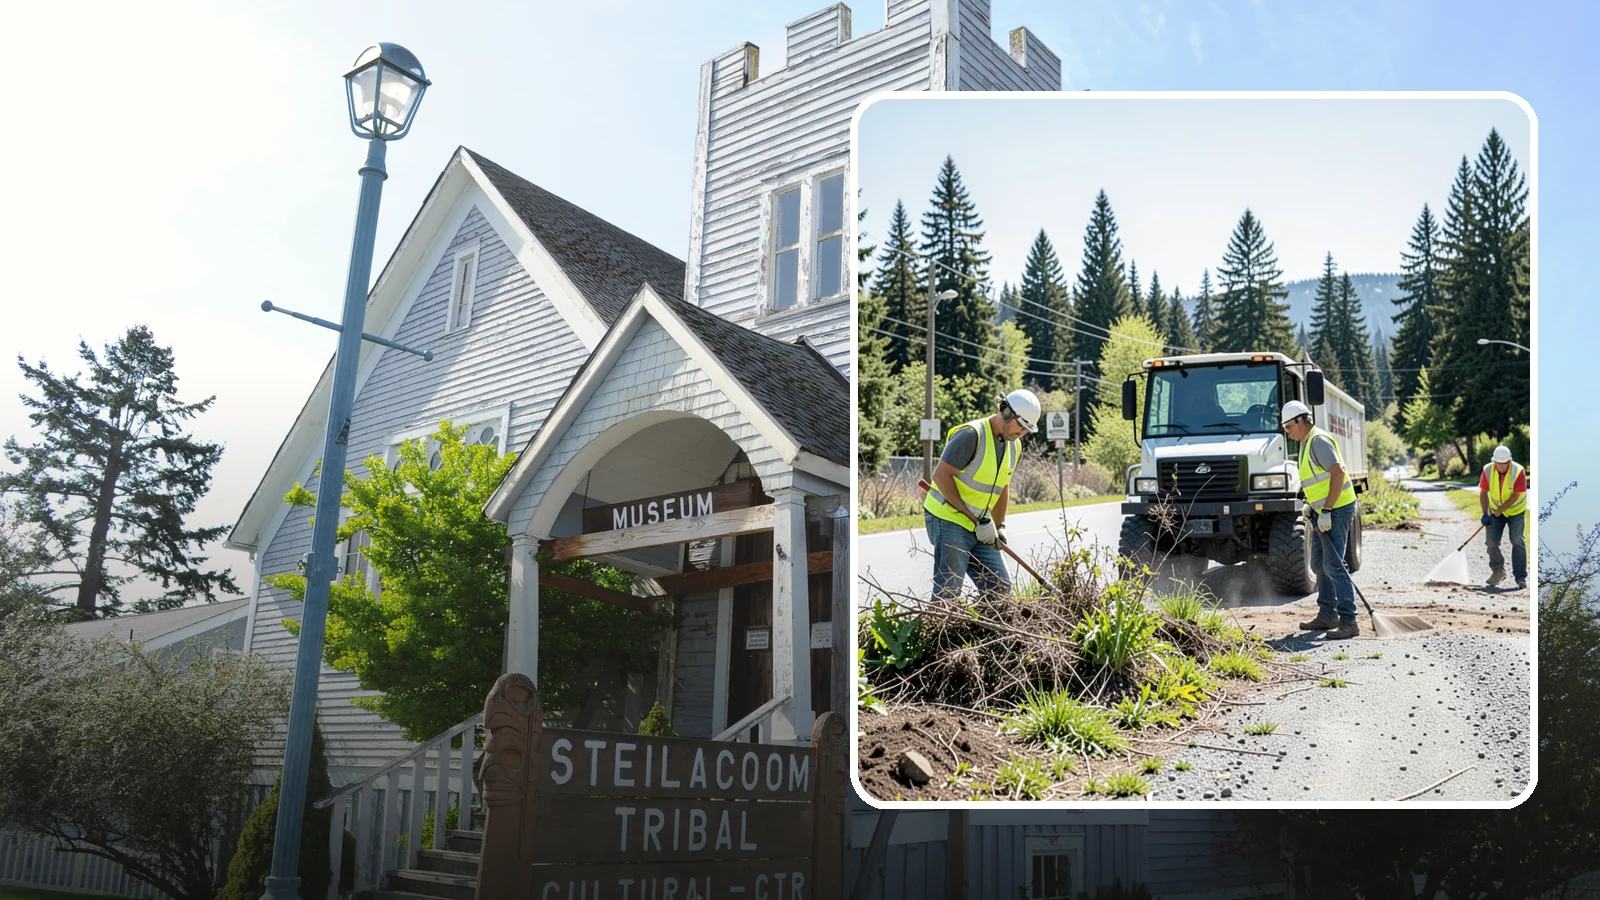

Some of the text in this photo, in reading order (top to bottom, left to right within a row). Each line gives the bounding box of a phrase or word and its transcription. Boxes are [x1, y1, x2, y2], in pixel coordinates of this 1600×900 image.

[613, 491, 714, 530] MUSEUM
[550, 738, 810, 792] STEILACOOM
[615, 806, 757, 851] TRIBAL
